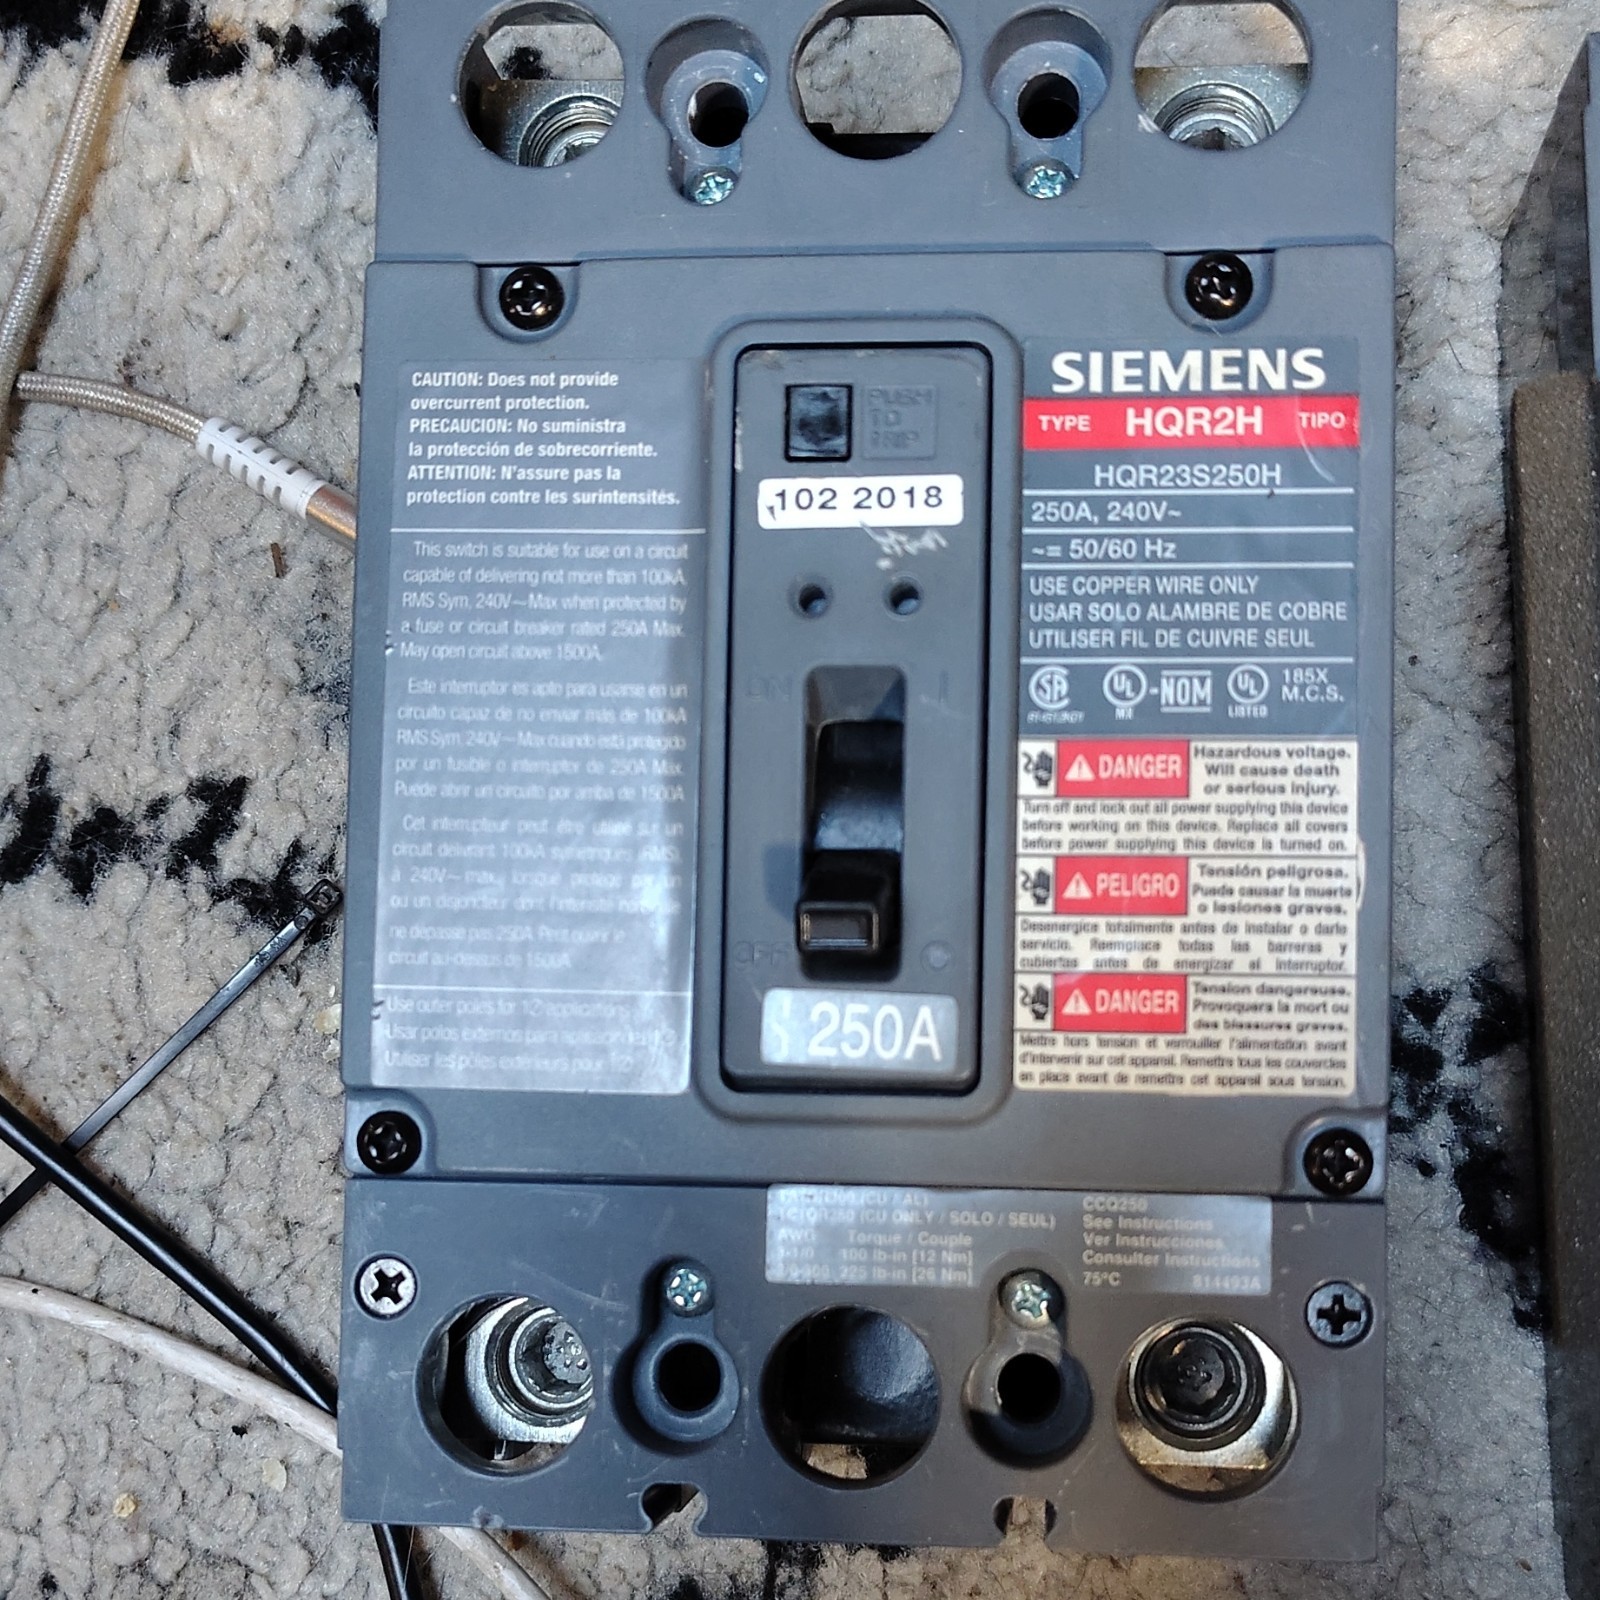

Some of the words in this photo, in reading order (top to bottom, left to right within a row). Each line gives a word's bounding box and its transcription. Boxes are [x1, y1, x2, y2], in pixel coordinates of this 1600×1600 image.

[411, 371, 484, 387] CAUTION:
[487, 371, 526, 387] Does
[529, 372, 557, 387] not
[559, 370, 620, 389] provide
[1051, 347, 1328, 394] SIEMENS
[410, 395, 502, 411] overcurrent
[504, 395, 590, 413] protection.
[409, 417, 512, 433] PRECAUCION:
[516, 417, 538, 433] No
[541, 417, 626, 433] suministra
[1038, 413, 1092, 433] TYPE
[1125, 405, 1264, 439] HQR2H
[1299, 410, 1348, 430] TIPO
[408, 441, 423, 457] la
[427, 441, 510, 460] protección
[514, 441, 534, 457] de
[538, 441, 658, 458] sobrecorriente.
[407, 465, 496, 481] ATTENTION:
[501, 465, 569, 481] N'assure
[573, 468, 603, 484] pas
[606, 465, 621, 481] la
[1093, 462, 1282, 488] HQR23S250H
[406, 489, 486, 508] protection
[490, 490, 541, 505] contre
[544, 489, 568, 505] les
[572, 489, 681, 506] surintensités.
[775, 488, 838, 510] 102
[854, 485, 942, 509] 2018
[1030, 501, 1099, 524] 250A,
[414, 540, 441, 557] This
[444, 541, 488, 558] switch
[492, 541, 504, 558] is
[507, 541, 559, 559] suitable
[562, 541, 580, 559] for
[584, 543, 610, 559] use
[613, 544, 631, 560] on
[635, 545, 644, 560] a
[647, 542, 689, 560] circuit
[1068, 538, 1138, 560] 50/60
[1144, 538, 1177, 559] Hz
[403, 567, 455, 585] capable
[459, 567, 471, 583] of
[475, 567, 539, 588] delivering
[542, 568, 564, 584] not
[568, 570, 602, 585] more
[607, 568, 636, 585] than
[1030, 575, 1069, 596] USE
[1071, 575, 1151, 596] COPPER
[1155, 575, 1204, 596] WIRE
[1209, 575, 1260, 595] ONLY
[1030, 601, 1082, 622] USAR
[1087, 601, 1141, 622] SOLO
[1146, 601, 1241, 622] ALAMBRE
[1246, 601, 1271, 621] DE
[1277, 600, 1348, 621] COBRE
[1029, 628, 1115, 649] UTILISER
[1120, 628, 1150, 649] FIL
[1155, 628, 1180, 649] DE
[1186, 627, 1259, 648] CUIVRE
[1264, 627, 1316, 648] SEUL
[1281, 667, 1330, 685] 185X
[1281, 684, 1345, 703] M.C.S.
[1227, 704, 1269, 719] LISTED
[1193, 745, 1281, 759] Hazardous
[1285, 745, 1352, 760] voltage.
[1098, 753, 1182, 780] DANGER
[1205, 763, 1236, 777] Will
[1239, 766, 1288, 777] cause
[1293, 763, 1340, 777] death
[1203, 783, 1220, 795] or
[1225, 781, 1285, 796] serious
[1290, 781, 1340, 797] injury.
[1024, 802, 1049, 815] Turn
[1053, 802, 1070, 815] off
[1074, 802, 1096, 815] and
[1100, 802, 1125, 815] lock
[1129, 803, 1149, 815] out
[1154, 802, 1168, 815] all
[1171, 804, 1211, 818] power
[1215, 801, 1276, 819] supplying
[1280, 801, 1302, 815] this
[1307, 801, 1348, 815] device
[1023, 820, 1062, 833] before
[1068, 820, 1118, 836] working
[1124, 823, 1140, 833] on
[1147, 820, 1170, 833] this
[1175, 820, 1221, 833] device.
[1227, 820, 1278, 835] Replace
[1284, 820, 1300, 833] all
[1305, 822, 1348, 834] covers
[1023, 838, 1062, 851] before
[1068, 840, 1108, 854] power
[1115, 838, 1176, 854] supplying
[1183, 838, 1206, 851] this
[1213, 838, 1254, 851] device
[1262, 838, 1273, 851] is
[1280, 838, 1322, 851] turned
[1328, 840, 1347, 851] on.
[1197, 863, 1262, 878] Tensión
[1266, 863, 1349, 882] peligrosa.
[1096, 872, 1181, 899] PELIGRO
[1192, 884, 1235, 898] Puede
[1238, 886, 1284, 898] causar
[1288, 884, 1301, 898] la
[1304, 885, 1352, 898] muerte
[1197, 903, 1208, 914] o
[1212, 901, 1282, 915] lesiones
[1288, 903, 1348, 917] graves.
[1193, 981, 1251, 996] Tension
[1255, 982, 1352, 998] dangereuse.
[1094, 989, 1180, 1015] DANGER
[808, 1001, 943, 1061] 250A
[950, 1210, 995, 1225] SOLO
[1008, 1211, 1057, 1231] SEUL)
[1083, 1214, 1113, 1230] See
[1119, 1215, 1214, 1231] Instructions
[848, 1229, 902, 1246] Torque
[918, 1231, 972, 1248] Couple
[1083, 1232, 1111, 1247] Ver
[840, 1248, 868, 1262] 100
[873, 1248, 907, 1263] lb-in
[911, 1248, 936, 1265] [12
[941, 1248, 973, 1267] Nm]
[1082, 1249, 1159, 1267] Consulter
[1165, 1252, 1261, 1269] Instructions
[1083, 1271, 1121, 1288] 75°C
